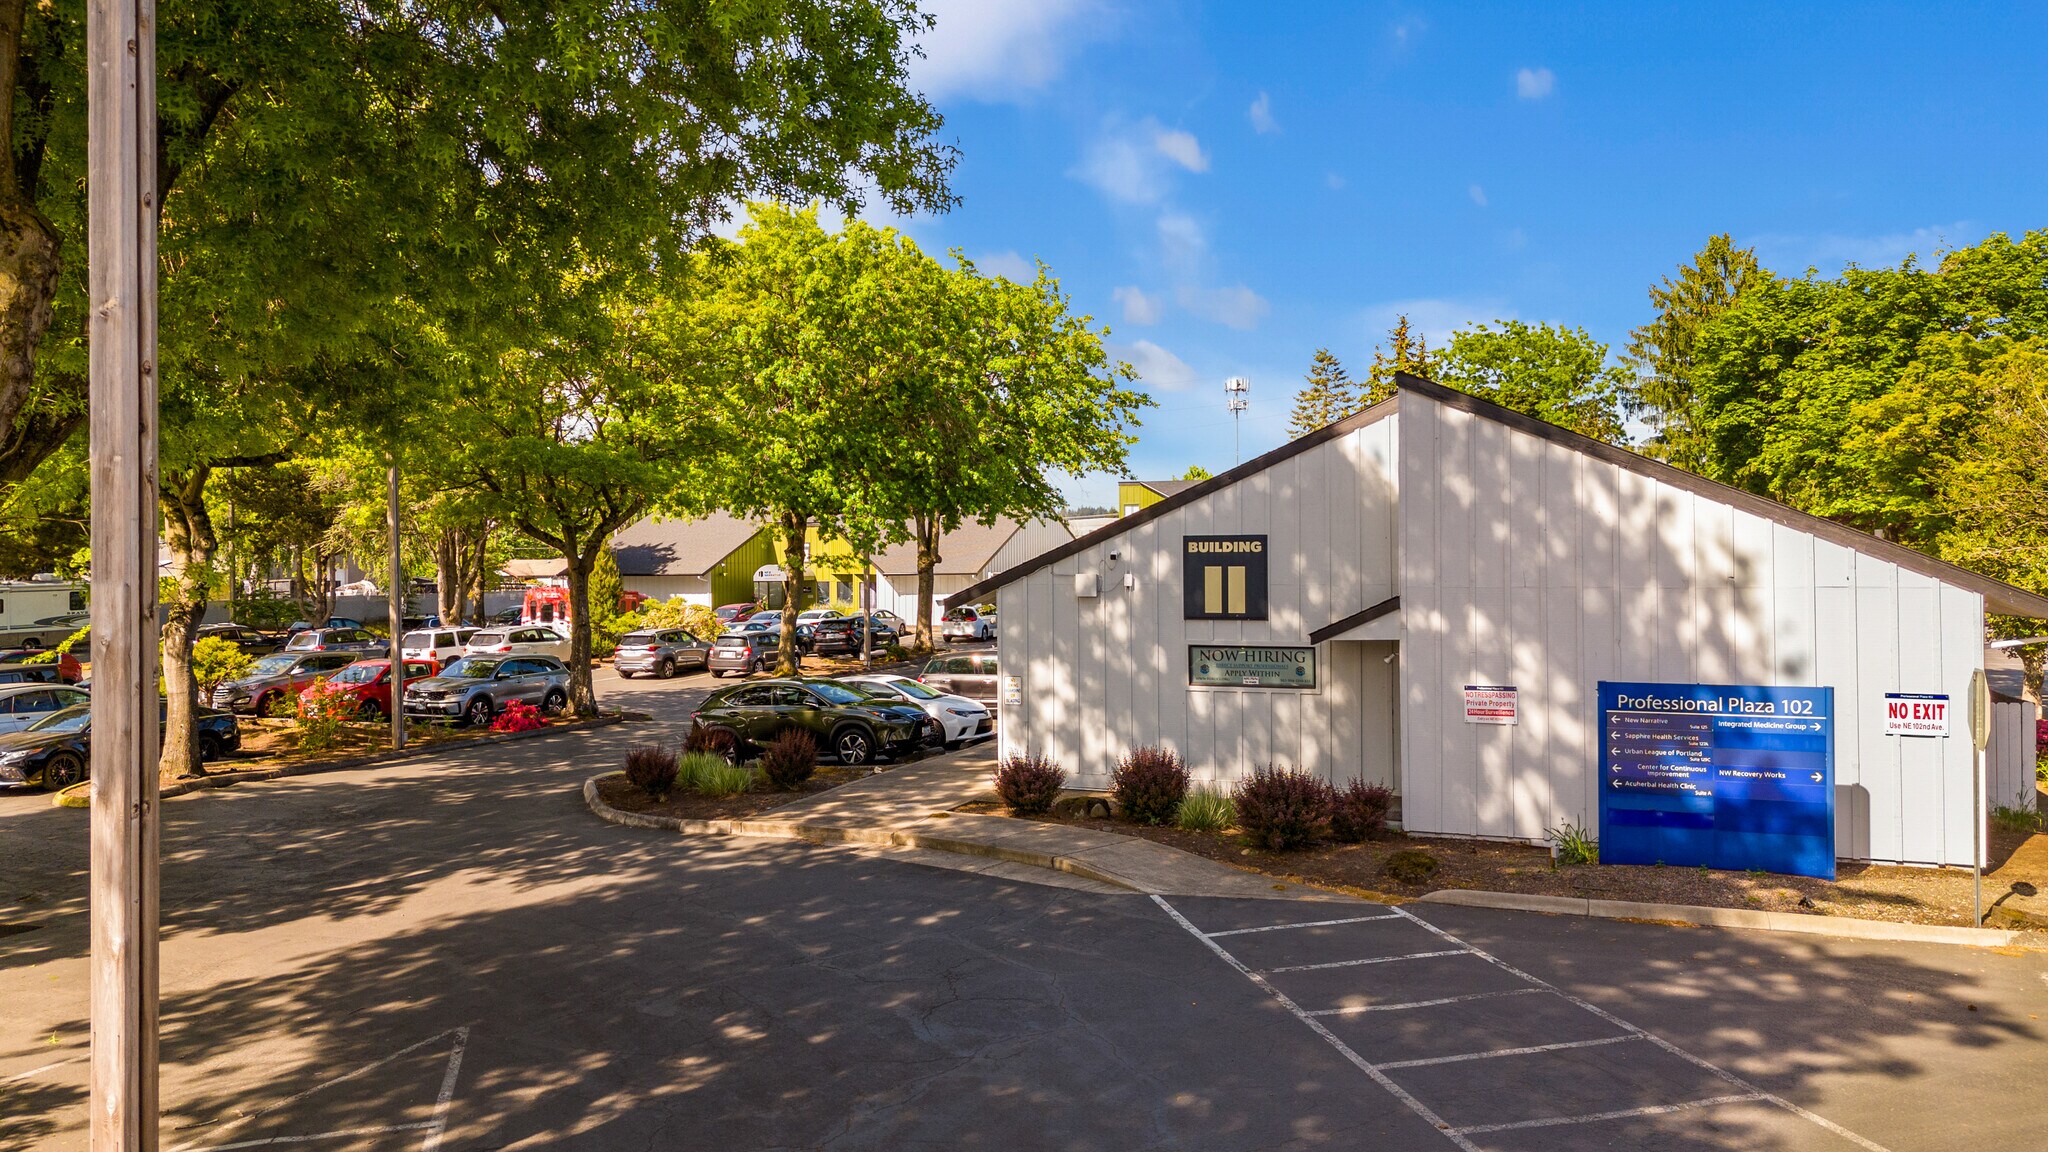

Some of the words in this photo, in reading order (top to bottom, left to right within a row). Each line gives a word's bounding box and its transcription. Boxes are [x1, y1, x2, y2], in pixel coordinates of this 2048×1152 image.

[1188, 541, 1262, 553] BUILDING
[1200, 649, 1240, 662] NOW
[1244, 650, 1306, 663] HIRING
[1224, 669, 1248, 677] APPLY
[1248, 669, 1280, 678] WITHIN
[1488, 700, 1515, 708] Property
[1617, 694, 1723, 712] Professional
[1728, 697, 1775, 713] Plaza
[1781, 699, 1813, 715] 102
[1888, 702, 1909, 720] NO
[1913, 703, 1945, 720] EXIT
[1718, 720, 1753, 728] Integrated
[1785, 722, 1807, 731] Group
[1902, 722, 1912, 730] NE
[1930, 723, 1945, 731] Ave.
[1624, 732, 1651, 740] Sapphire
[1644, 749, 1667, 757] League
[1675, 749, 1703, 757] Portland
[1670, 764, 1707, 773] Continuous
[1732, 770, 1763, 779] Recovery
[1763, 771, 1786, 779] Works
[1624, 780, 1657, 788] Acuherbal
